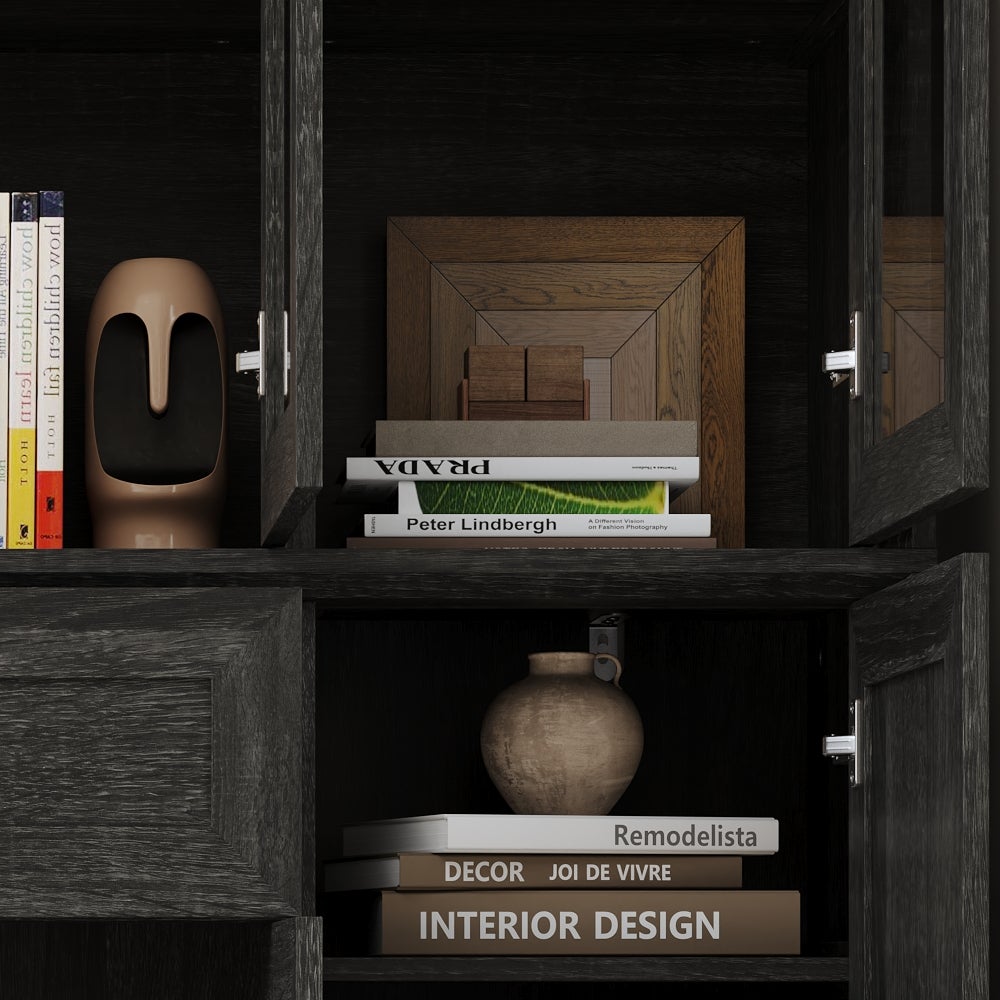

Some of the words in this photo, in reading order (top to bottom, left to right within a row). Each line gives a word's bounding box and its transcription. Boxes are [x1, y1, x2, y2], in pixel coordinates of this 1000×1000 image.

[373, 459, 489, 475] PRADA
[407, 518, 456, 531] Peter
[461, 517, 556, 535] Lindbergh
[613, 824, 757, 847] Remodelista
[445, 861, 525, 882] DECOR
[549, 864, 578, 882] JOI
[586, 864, 610, 881] DE
[616, 865, 671, 882] VIVRE
[419, 910, 581, 940] INTERIOR
[594, 910, 720, 940] DESIGN
